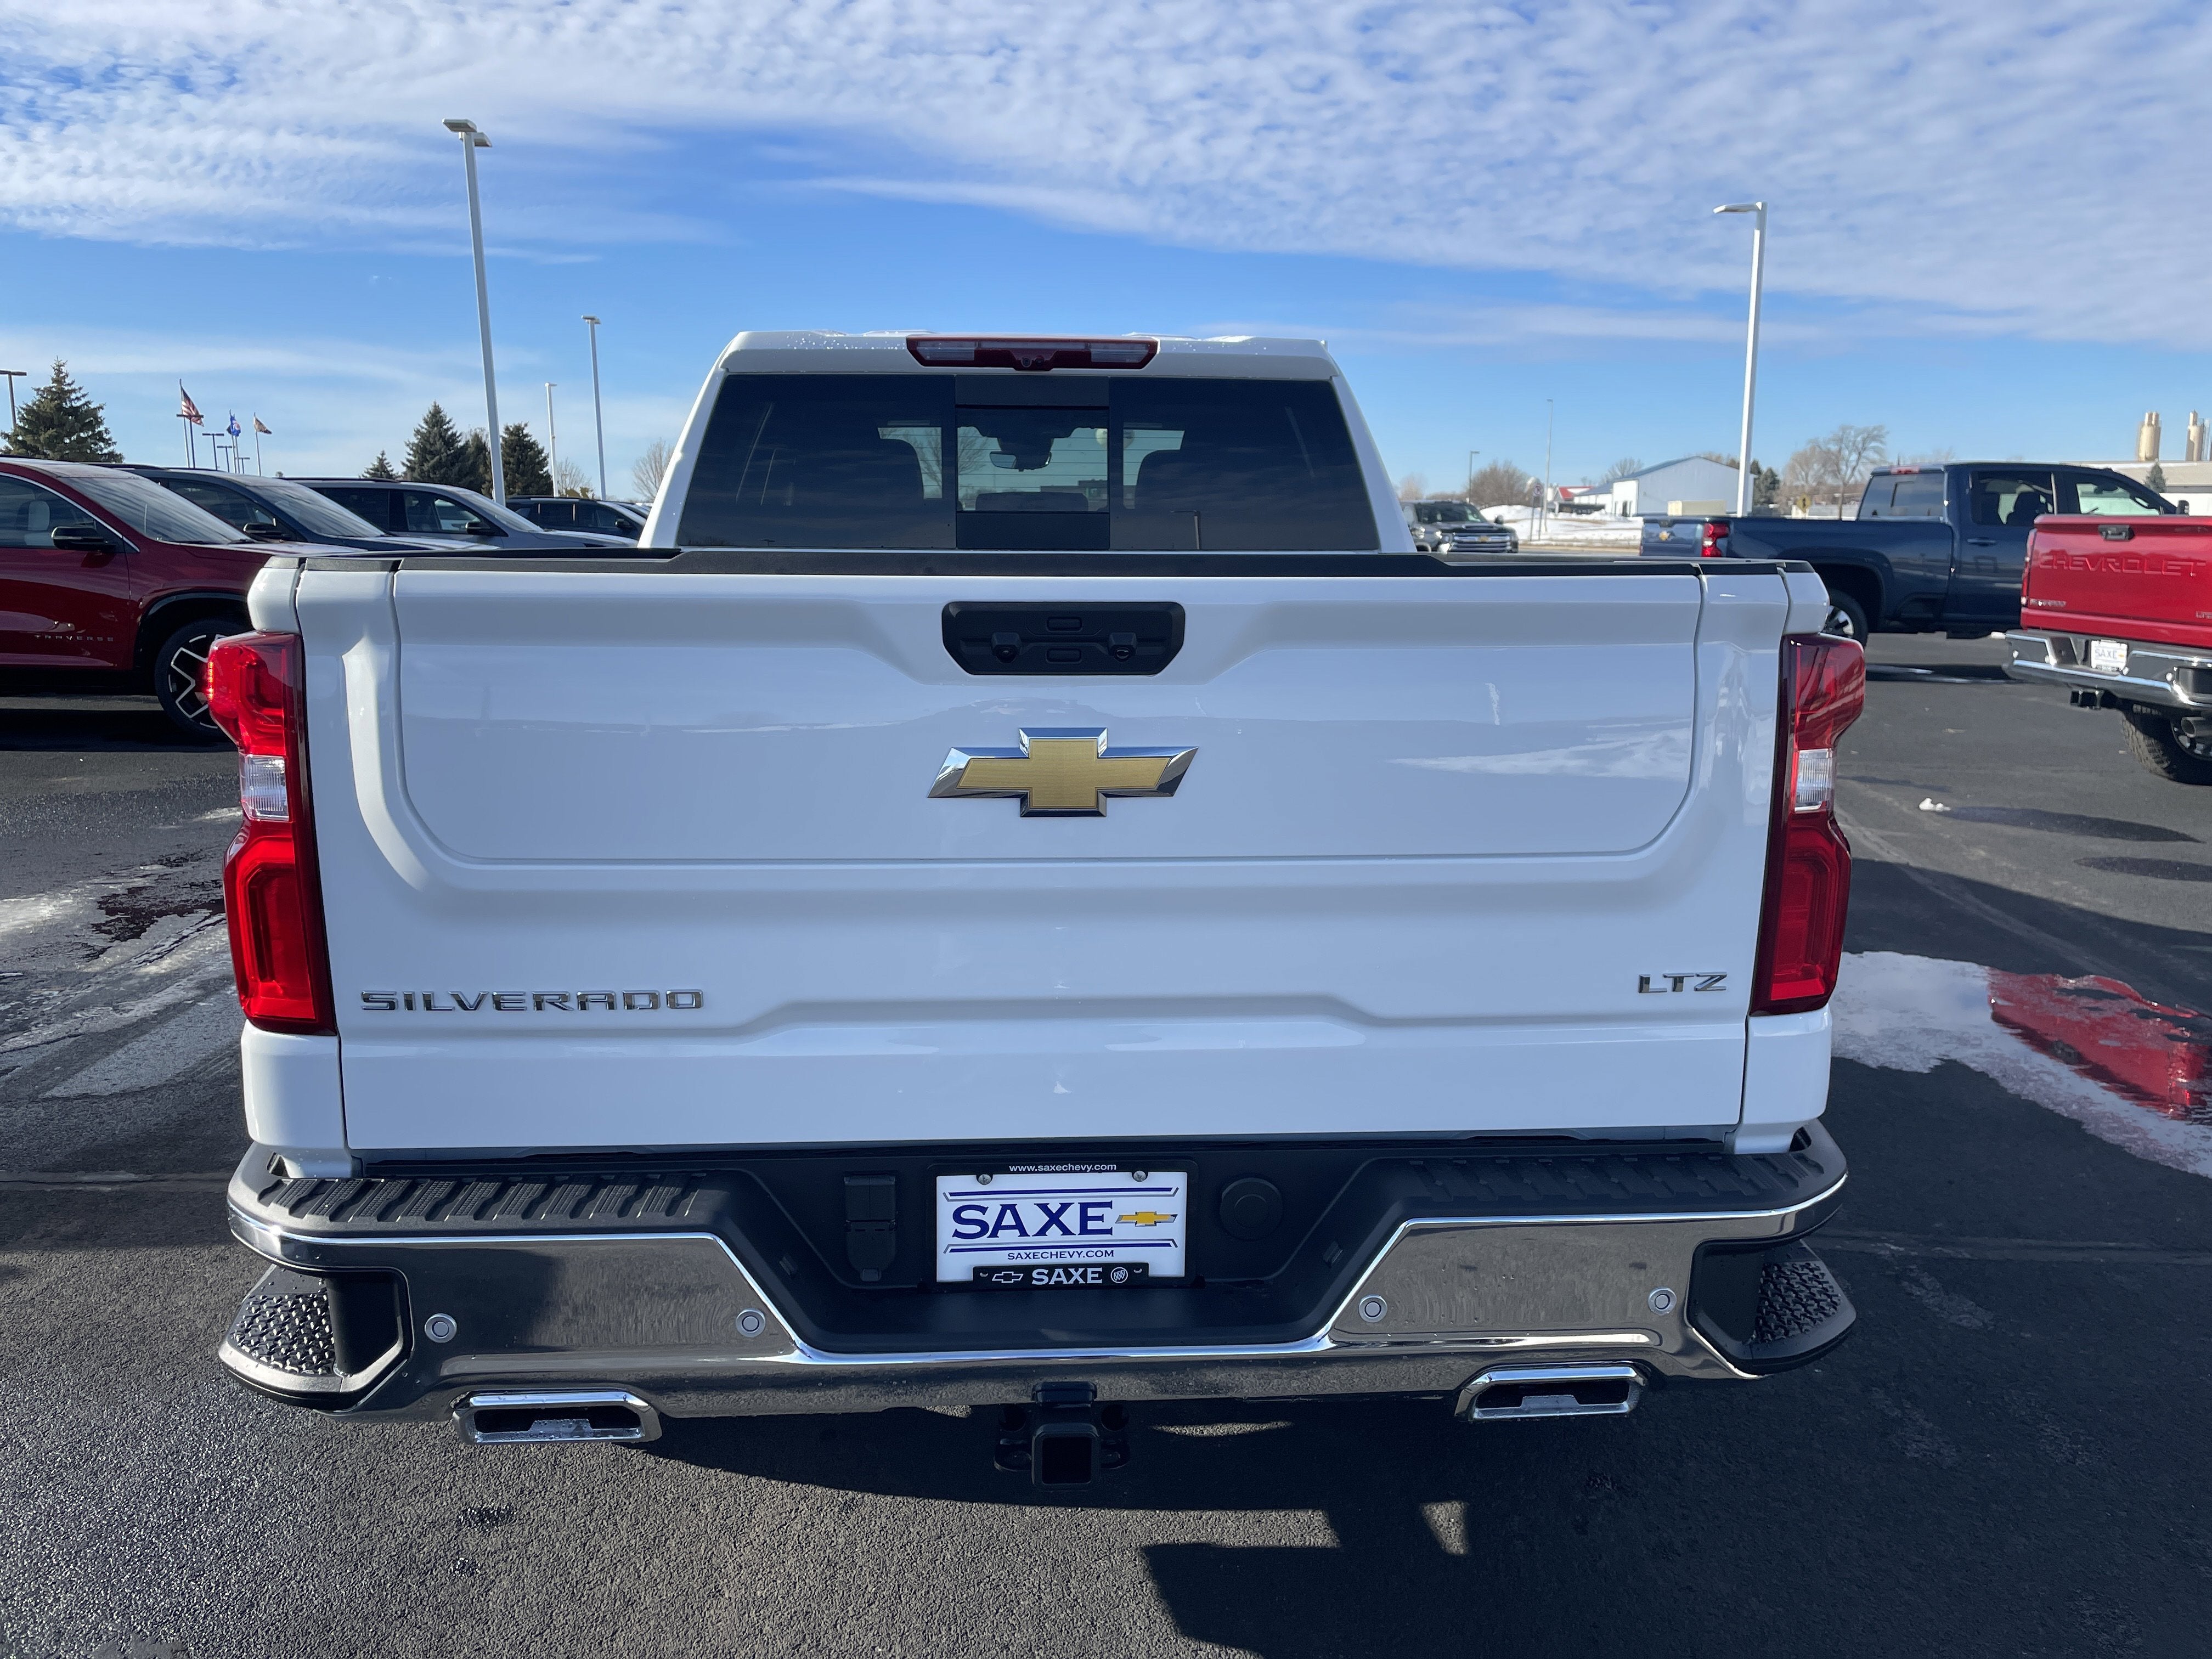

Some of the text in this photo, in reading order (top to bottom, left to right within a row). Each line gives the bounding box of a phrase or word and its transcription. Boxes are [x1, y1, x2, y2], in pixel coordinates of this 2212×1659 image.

[2039, 555, 2207, 577] CHEVROLET
[2095, 648, 2118, 659] SAXE
[1638, 971, 1728, 994] LTZ
[361, 990, 705, 1012] SILVERADO
[1009, 1163, 1117, 1173] www.saxechevy.com
[952, 1201, 1113, 1239] SAXE
[1007, 1249, 1115, 1260] SAXECHEVY.COM
[1031, 1267, 1103, 1285] SAXE
